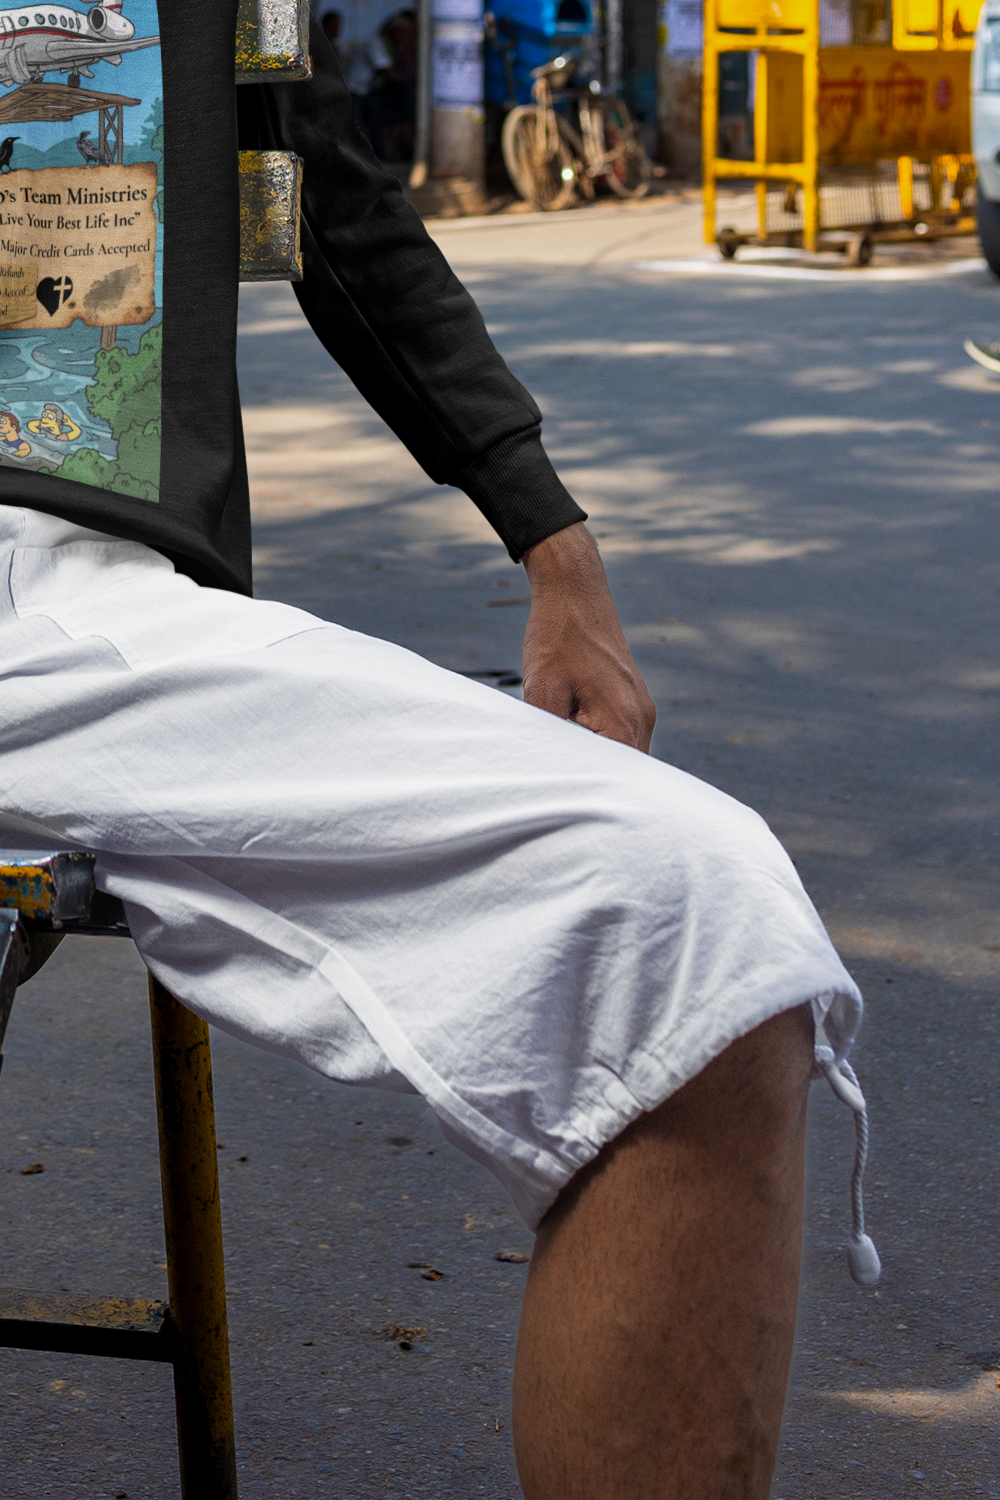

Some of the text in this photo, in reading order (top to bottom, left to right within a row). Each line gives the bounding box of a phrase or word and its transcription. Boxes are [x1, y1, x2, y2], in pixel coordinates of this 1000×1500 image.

[20, 187, 62, 205] Team
[67, 185, 148, 205] Ministries
[26, 212, 54, 229] Your
[56, 215, 82, 230] Best
[85, 212, 110, 229] Life
[0, 239, 28, 258] Major
[29, 243, 61, 258] Credit
[63, 242, 95, 258] Cards
[97, 238, 150, 258] Accepted
